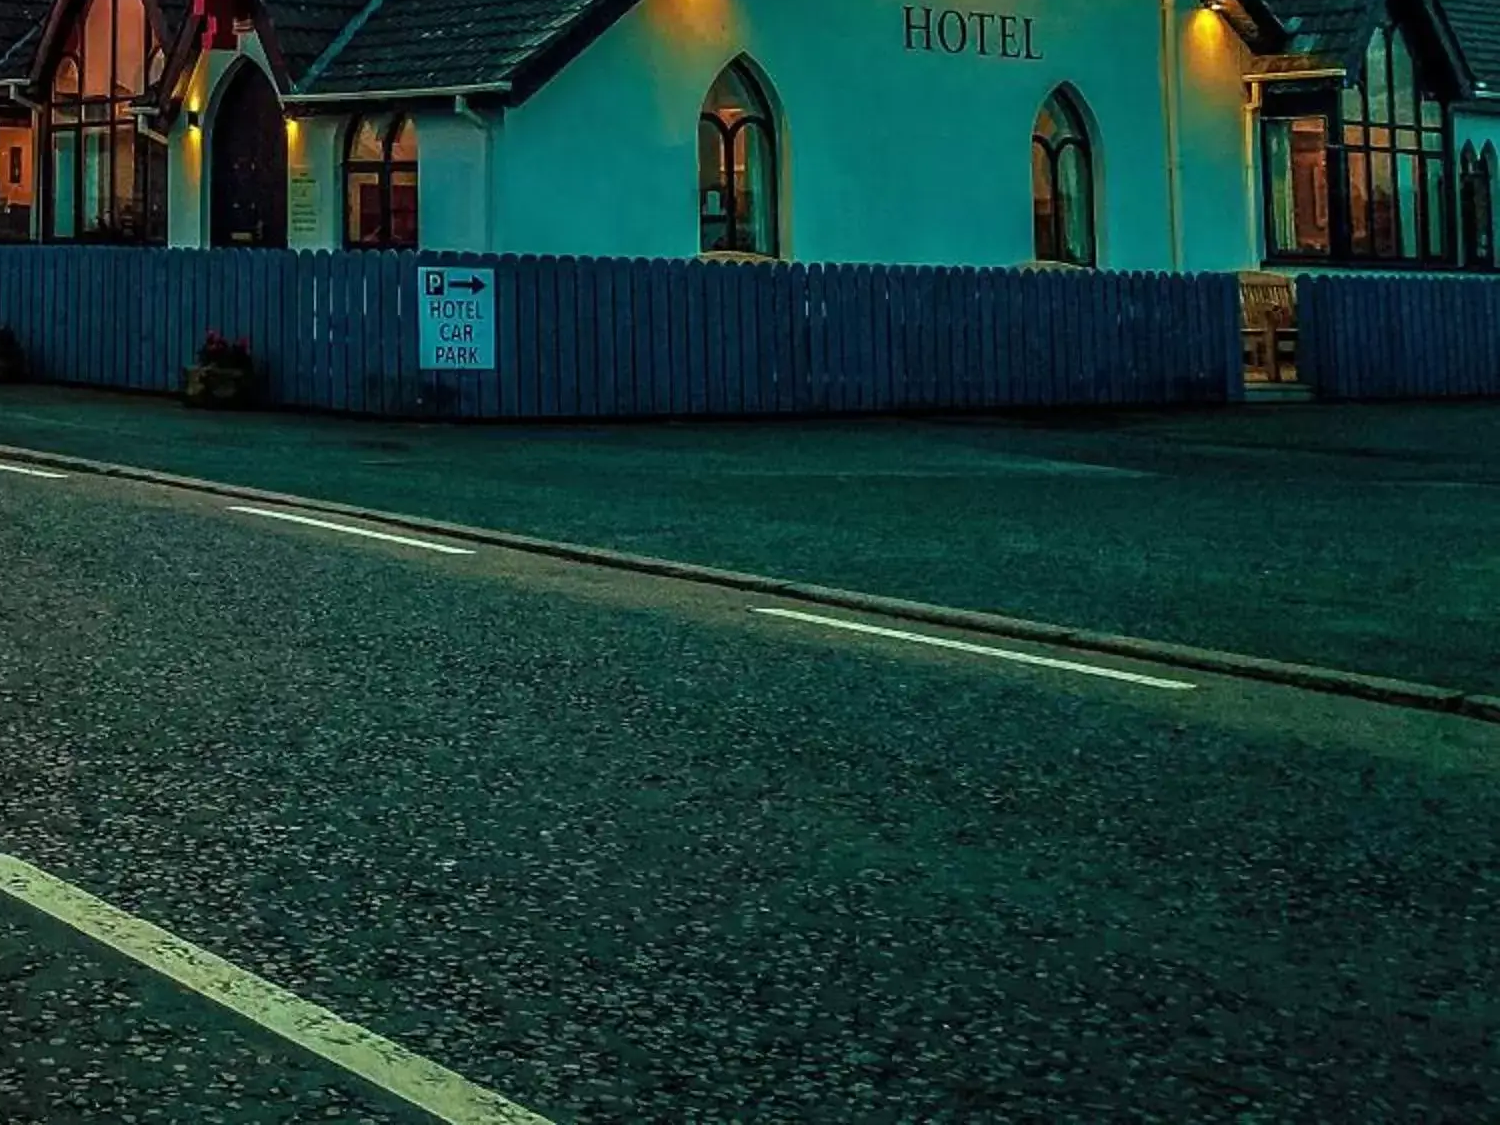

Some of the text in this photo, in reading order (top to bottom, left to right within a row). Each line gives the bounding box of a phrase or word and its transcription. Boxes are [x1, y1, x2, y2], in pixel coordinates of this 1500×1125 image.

[903, 5, 1043, 60] HOTEL
[429, 300, 484, 320] HOTEL
[440, 323, 473, 342] CAR
[435, 346, 479, 364] PARK
